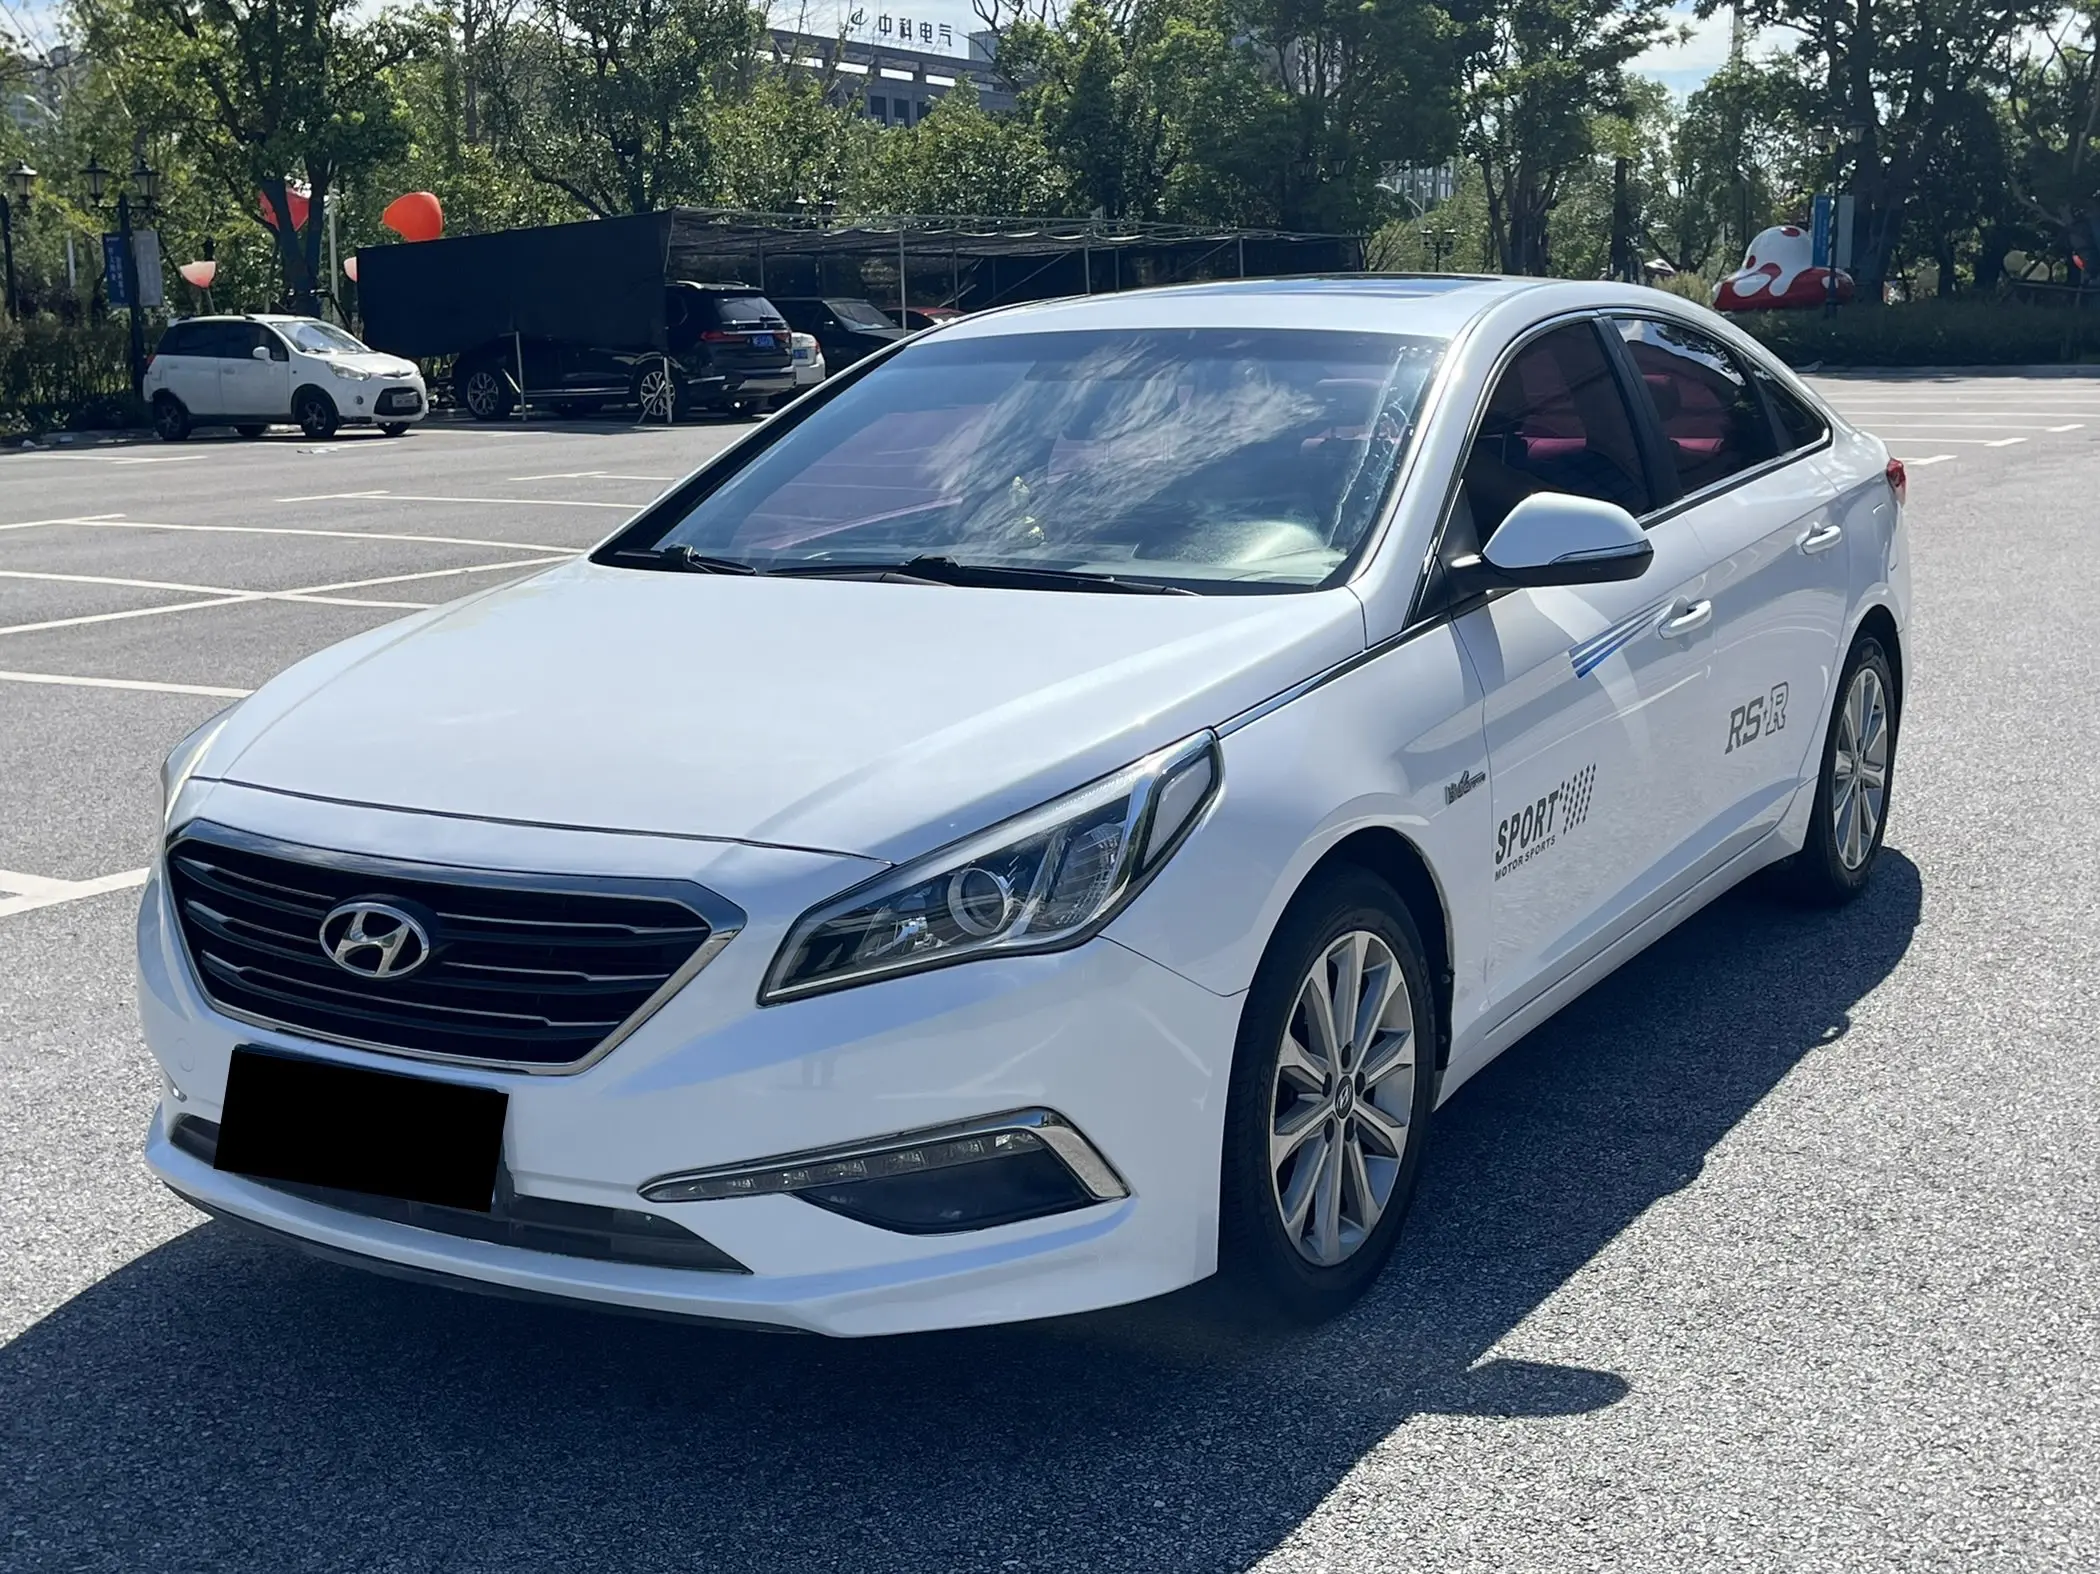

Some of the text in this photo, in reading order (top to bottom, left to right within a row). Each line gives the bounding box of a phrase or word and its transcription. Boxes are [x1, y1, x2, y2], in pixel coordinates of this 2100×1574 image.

[879, 13, 952, 47] 中科电气
[1495, 789, 1559, 865] SPORT
[1494, 834, 1556, 882] MOTOR SPORTS
